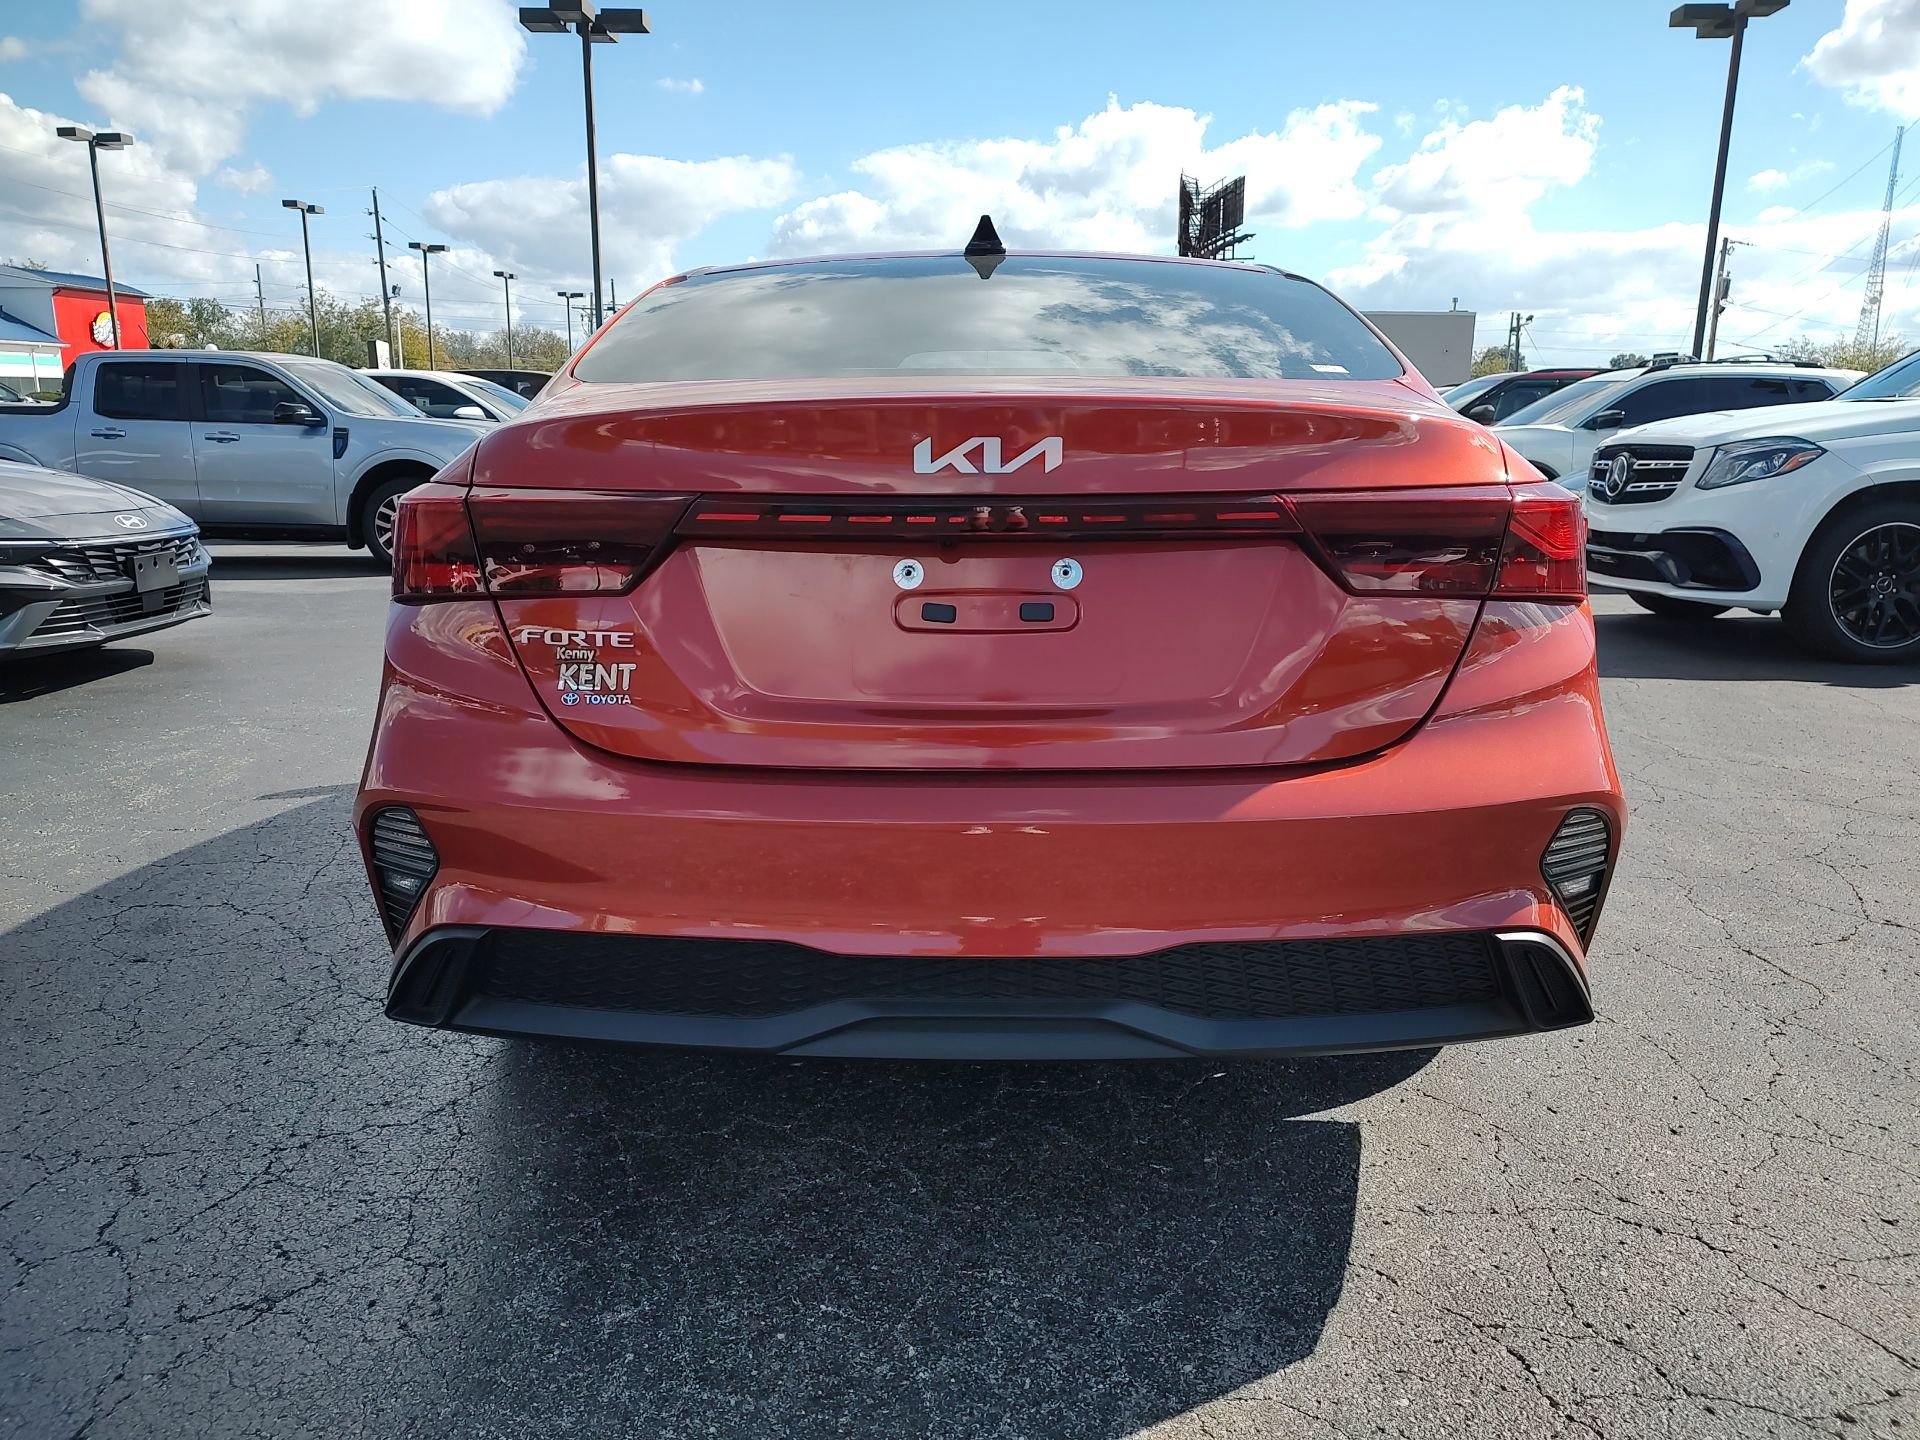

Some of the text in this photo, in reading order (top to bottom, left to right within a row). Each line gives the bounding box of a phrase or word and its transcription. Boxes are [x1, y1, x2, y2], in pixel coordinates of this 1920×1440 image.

[913, 436, 1064, 474] KIA
[521, 629, 635, 648] FORTE
[556, 647, 595, 662] Kenny
[557, 663, 637, 691] KENT
[584, 694, 632, 704] TOYOTA
